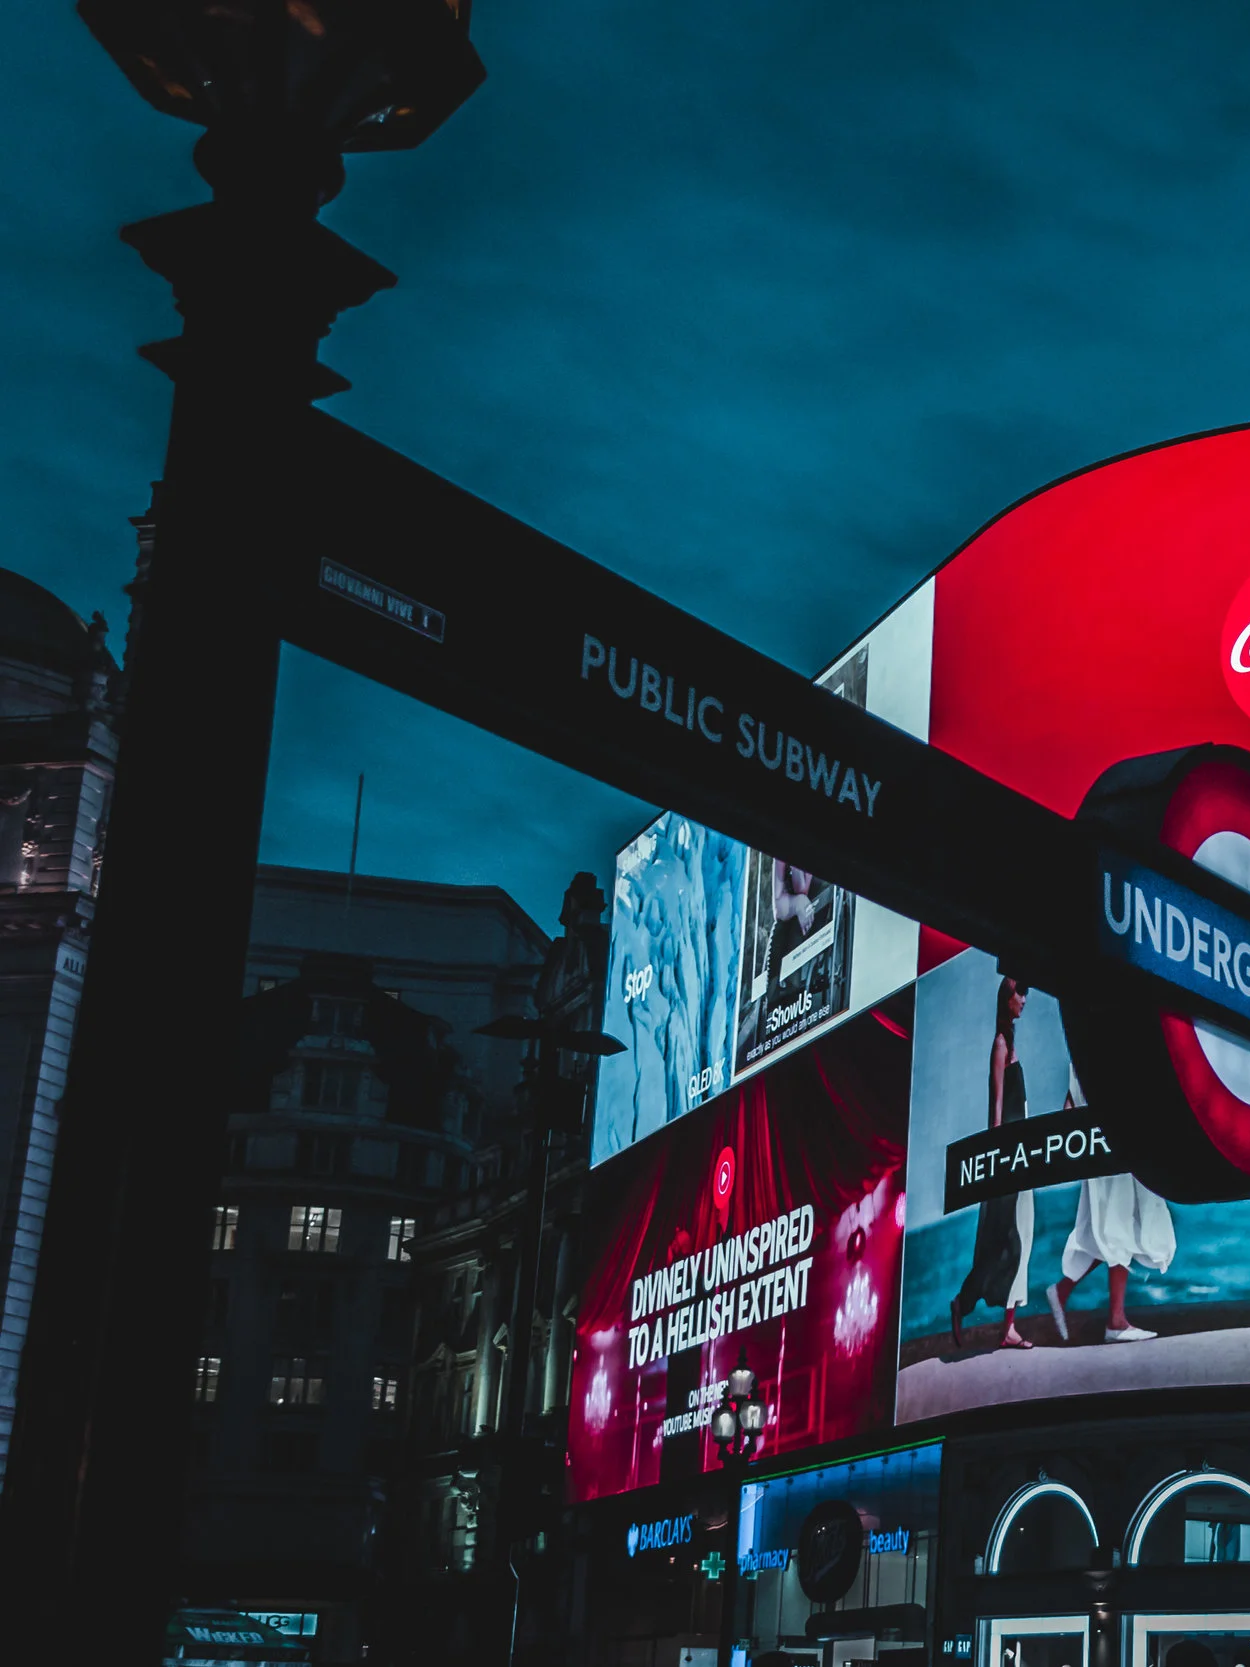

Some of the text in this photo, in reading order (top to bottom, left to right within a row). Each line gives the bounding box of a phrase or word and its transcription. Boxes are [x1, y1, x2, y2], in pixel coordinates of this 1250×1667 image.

[581, 633, 882, 818] PUBLIC SUBWAY
[624, 964, 653, 1003] Stop
[765, 990, 812, 1035] #ShowUs
[689, 1067, 712, 1098] QLED
[631, 1204, 815, 1321] DIVINELY UNINSPIRED
[628, 1257, 814, 1369] TO A HELLISH EXTENT
[688, 1389, 700, 1408] ON
[713, 1380, 729, 1401] NE
[663, 1405, 717, 1437] YOUTUBE MUSI
[640, 1513, 693, 1550] BARCLAYS
[869, 1526, 910, 1555] beauty
[739, 1549, 789, 1576] pharmacy
[957, 1640, 971, 1653] GAP
